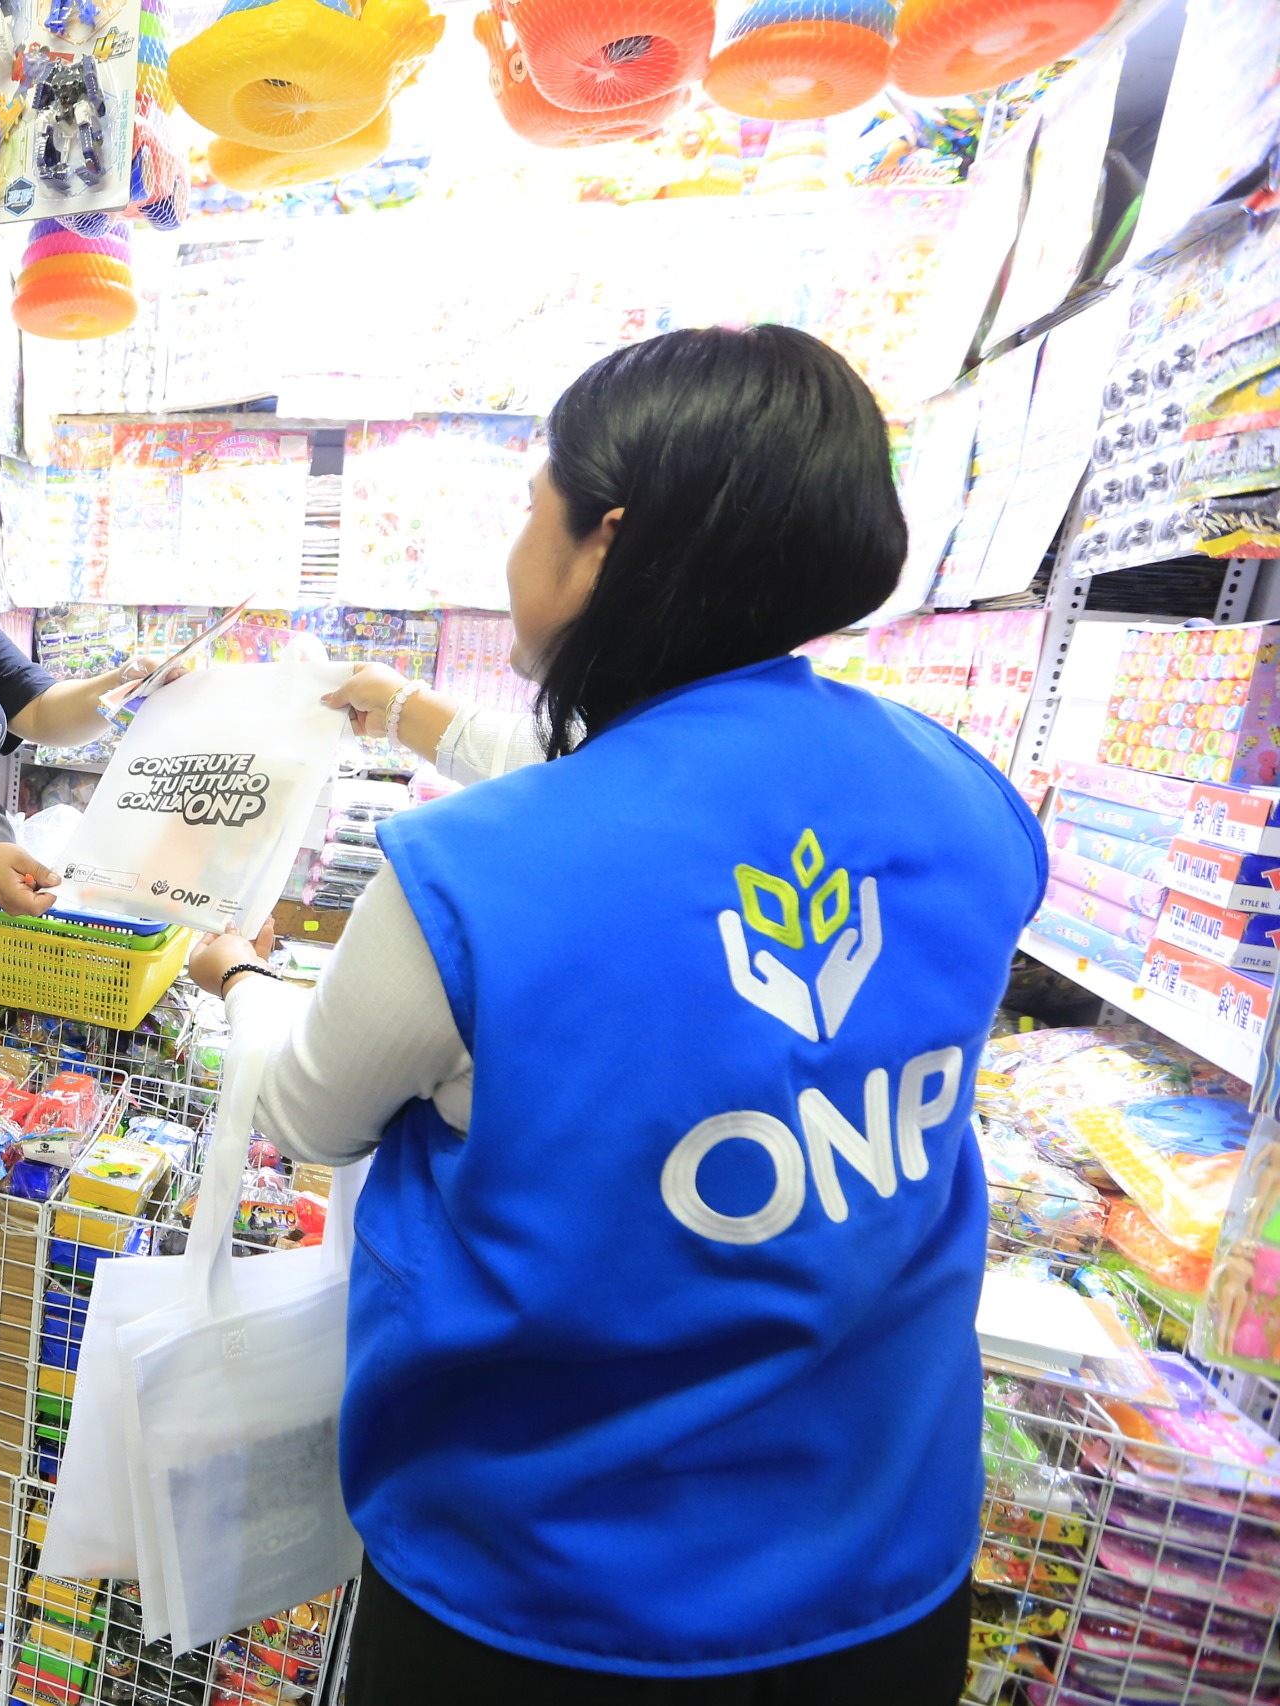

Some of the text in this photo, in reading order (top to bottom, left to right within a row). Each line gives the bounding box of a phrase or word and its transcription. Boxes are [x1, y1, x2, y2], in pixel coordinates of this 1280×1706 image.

[128, 754, 255, 776] CONSTRUYE
[151, 773, 270, 795] TU FUTURO
[117, 792, 266, 827] CON LA ONP
[1173, 852, 1219, 884] TUN HUANG
[170, 889, 210, 907] ONP
[1239, 898, 1271, 910] STYLE NO.
[1241, 956, 1262, 966] STYLE
[660, 1046, 964, 1244] ONP
